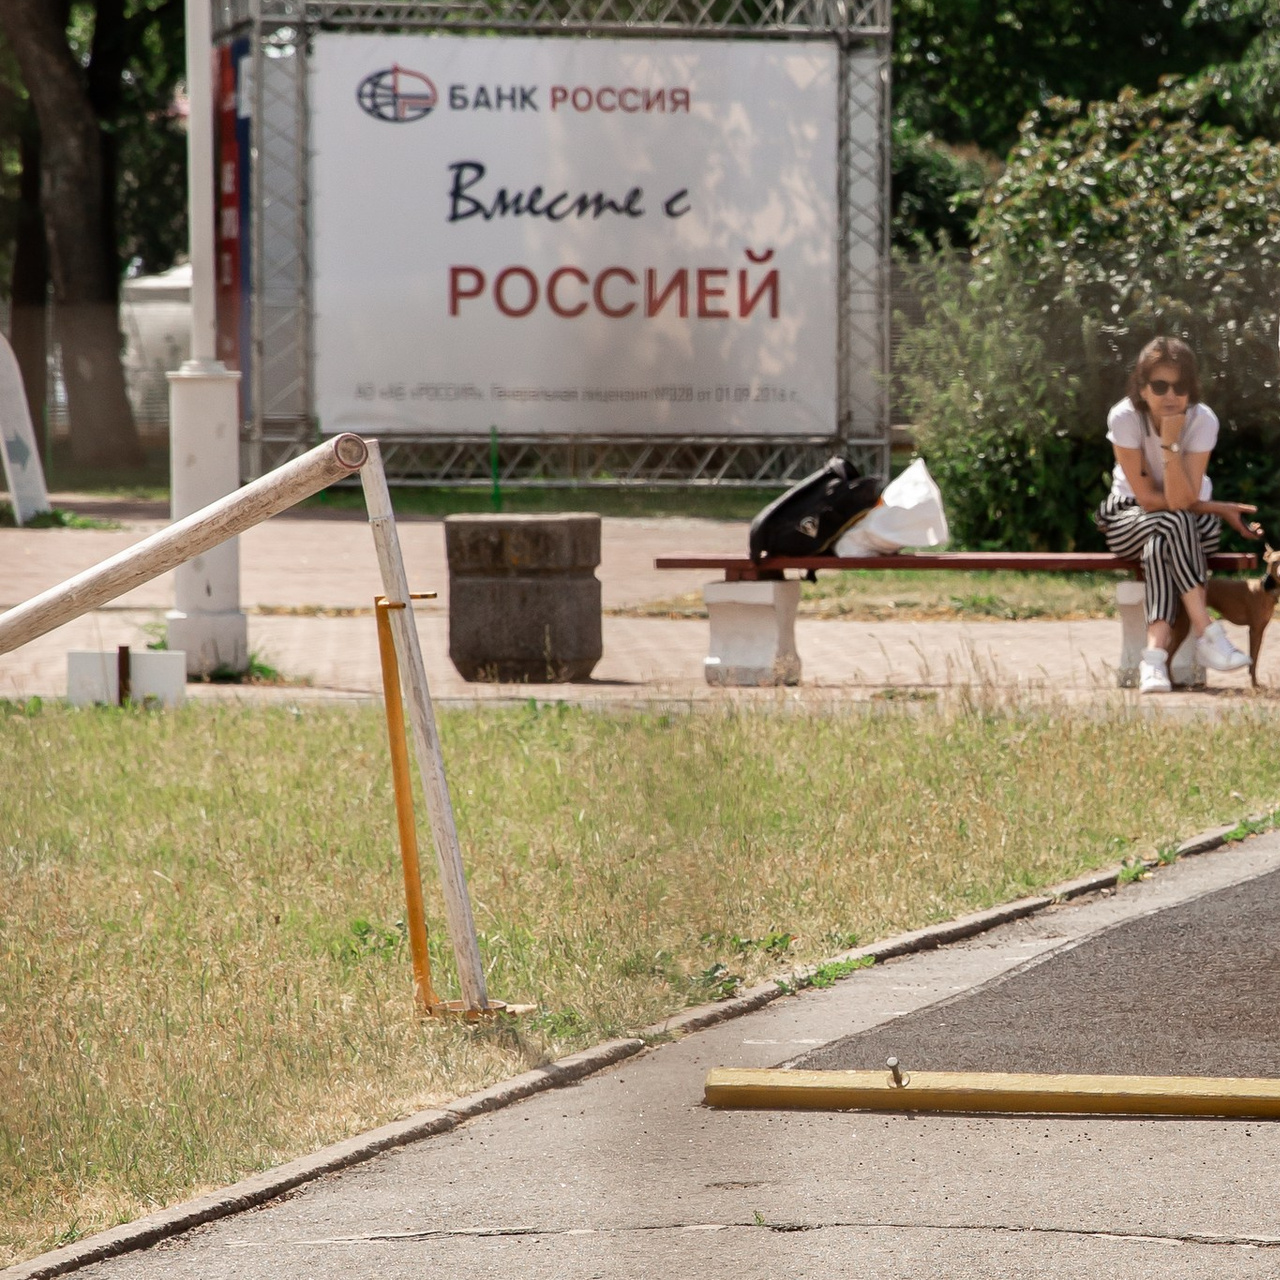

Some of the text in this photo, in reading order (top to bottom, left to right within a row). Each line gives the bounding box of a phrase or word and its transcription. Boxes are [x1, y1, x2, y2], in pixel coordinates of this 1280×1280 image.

[449, 84, 690, 113] БАНК РОССИЯ
[447, 160, 692, 221] Вместе с
[448, 247, 780, 320] РОССИЕЙ
